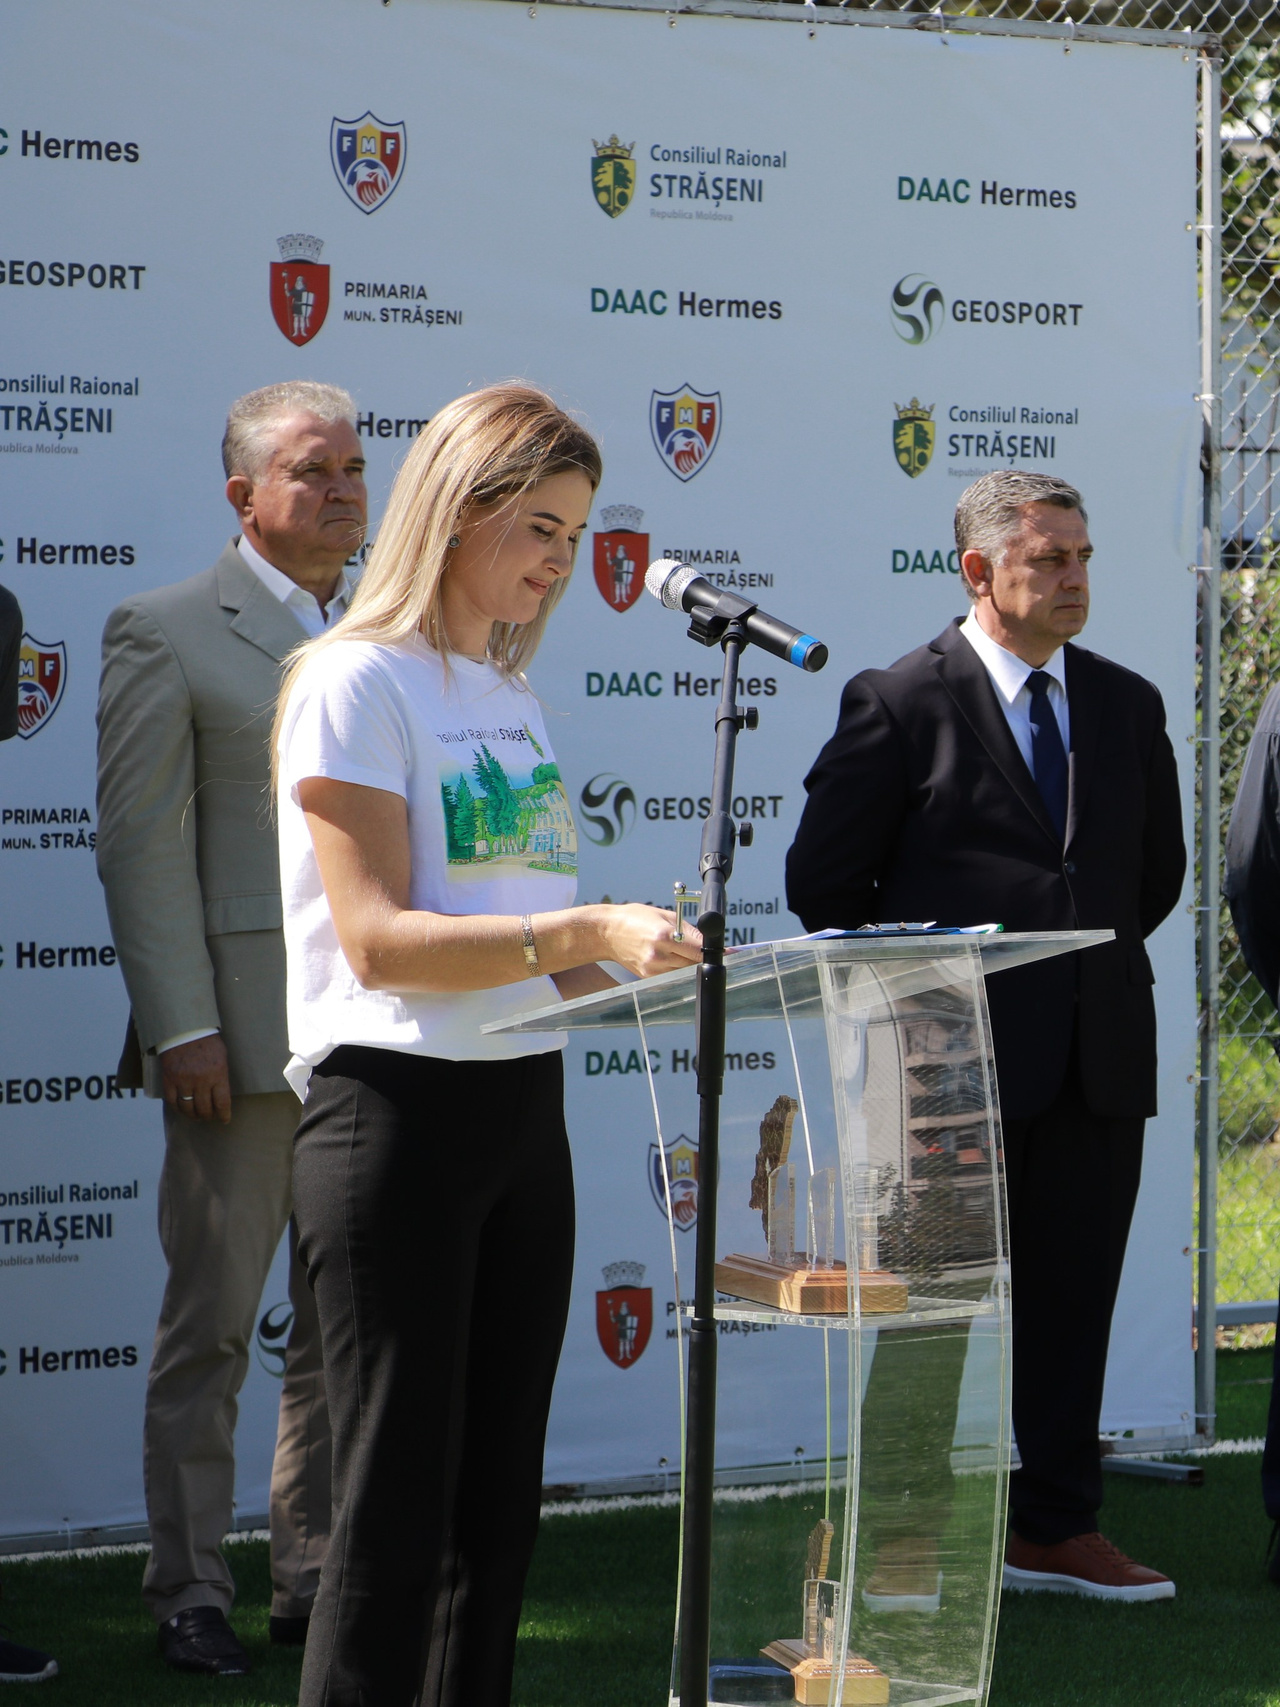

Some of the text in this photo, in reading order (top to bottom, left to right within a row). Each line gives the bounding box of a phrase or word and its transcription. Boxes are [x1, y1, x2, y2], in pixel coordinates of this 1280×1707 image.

[21, 130, 140, 163] Hermes
[650, 144, 786, 168] Consiliul Raional
[897, 176, 1077, 209] DAAC Hermes
[650, 208, 734, 221] Republica Moldova
[344, 282, 428, 300] PRIMARIA
[590, 288, 783, 320] DAAC Hermes
[344, 310, 376, 322] MUN.
[951, 299, 1084, 326] GEOSPORT
[0, 374, 139, 396] onsiliul Raional
[0, 400, 112, 440] TRĂȘENI
[357, 411, 430, 438] Herm
[948, 405, 1079, 425] Consiliul Raional
[35, 443, 79, 454] Moldova
[17, 537, 135, 566] Hermes
[663, 549, 741, 564] PRIMARIA
[19, 659, 56, 678] MF
[586, 671, 663, 697] DAAC
[2, 807, 91, 825] PRIMARIA
[644, 795, 783, 821] GEOSORT
[1, 828, 97, 852] MUN. STRĂȘ
[16, 942, 116, 968] Herme
[585, 1049, 661, 1076] DAAC
[0, 1180, 138, 1207] onsiliul Raional
[0, 1211, 112, 1249] TRĂȘENI
[36, 1253, 79, 1264] Moldova
[19, 1343, 138, 1374] Hermes
